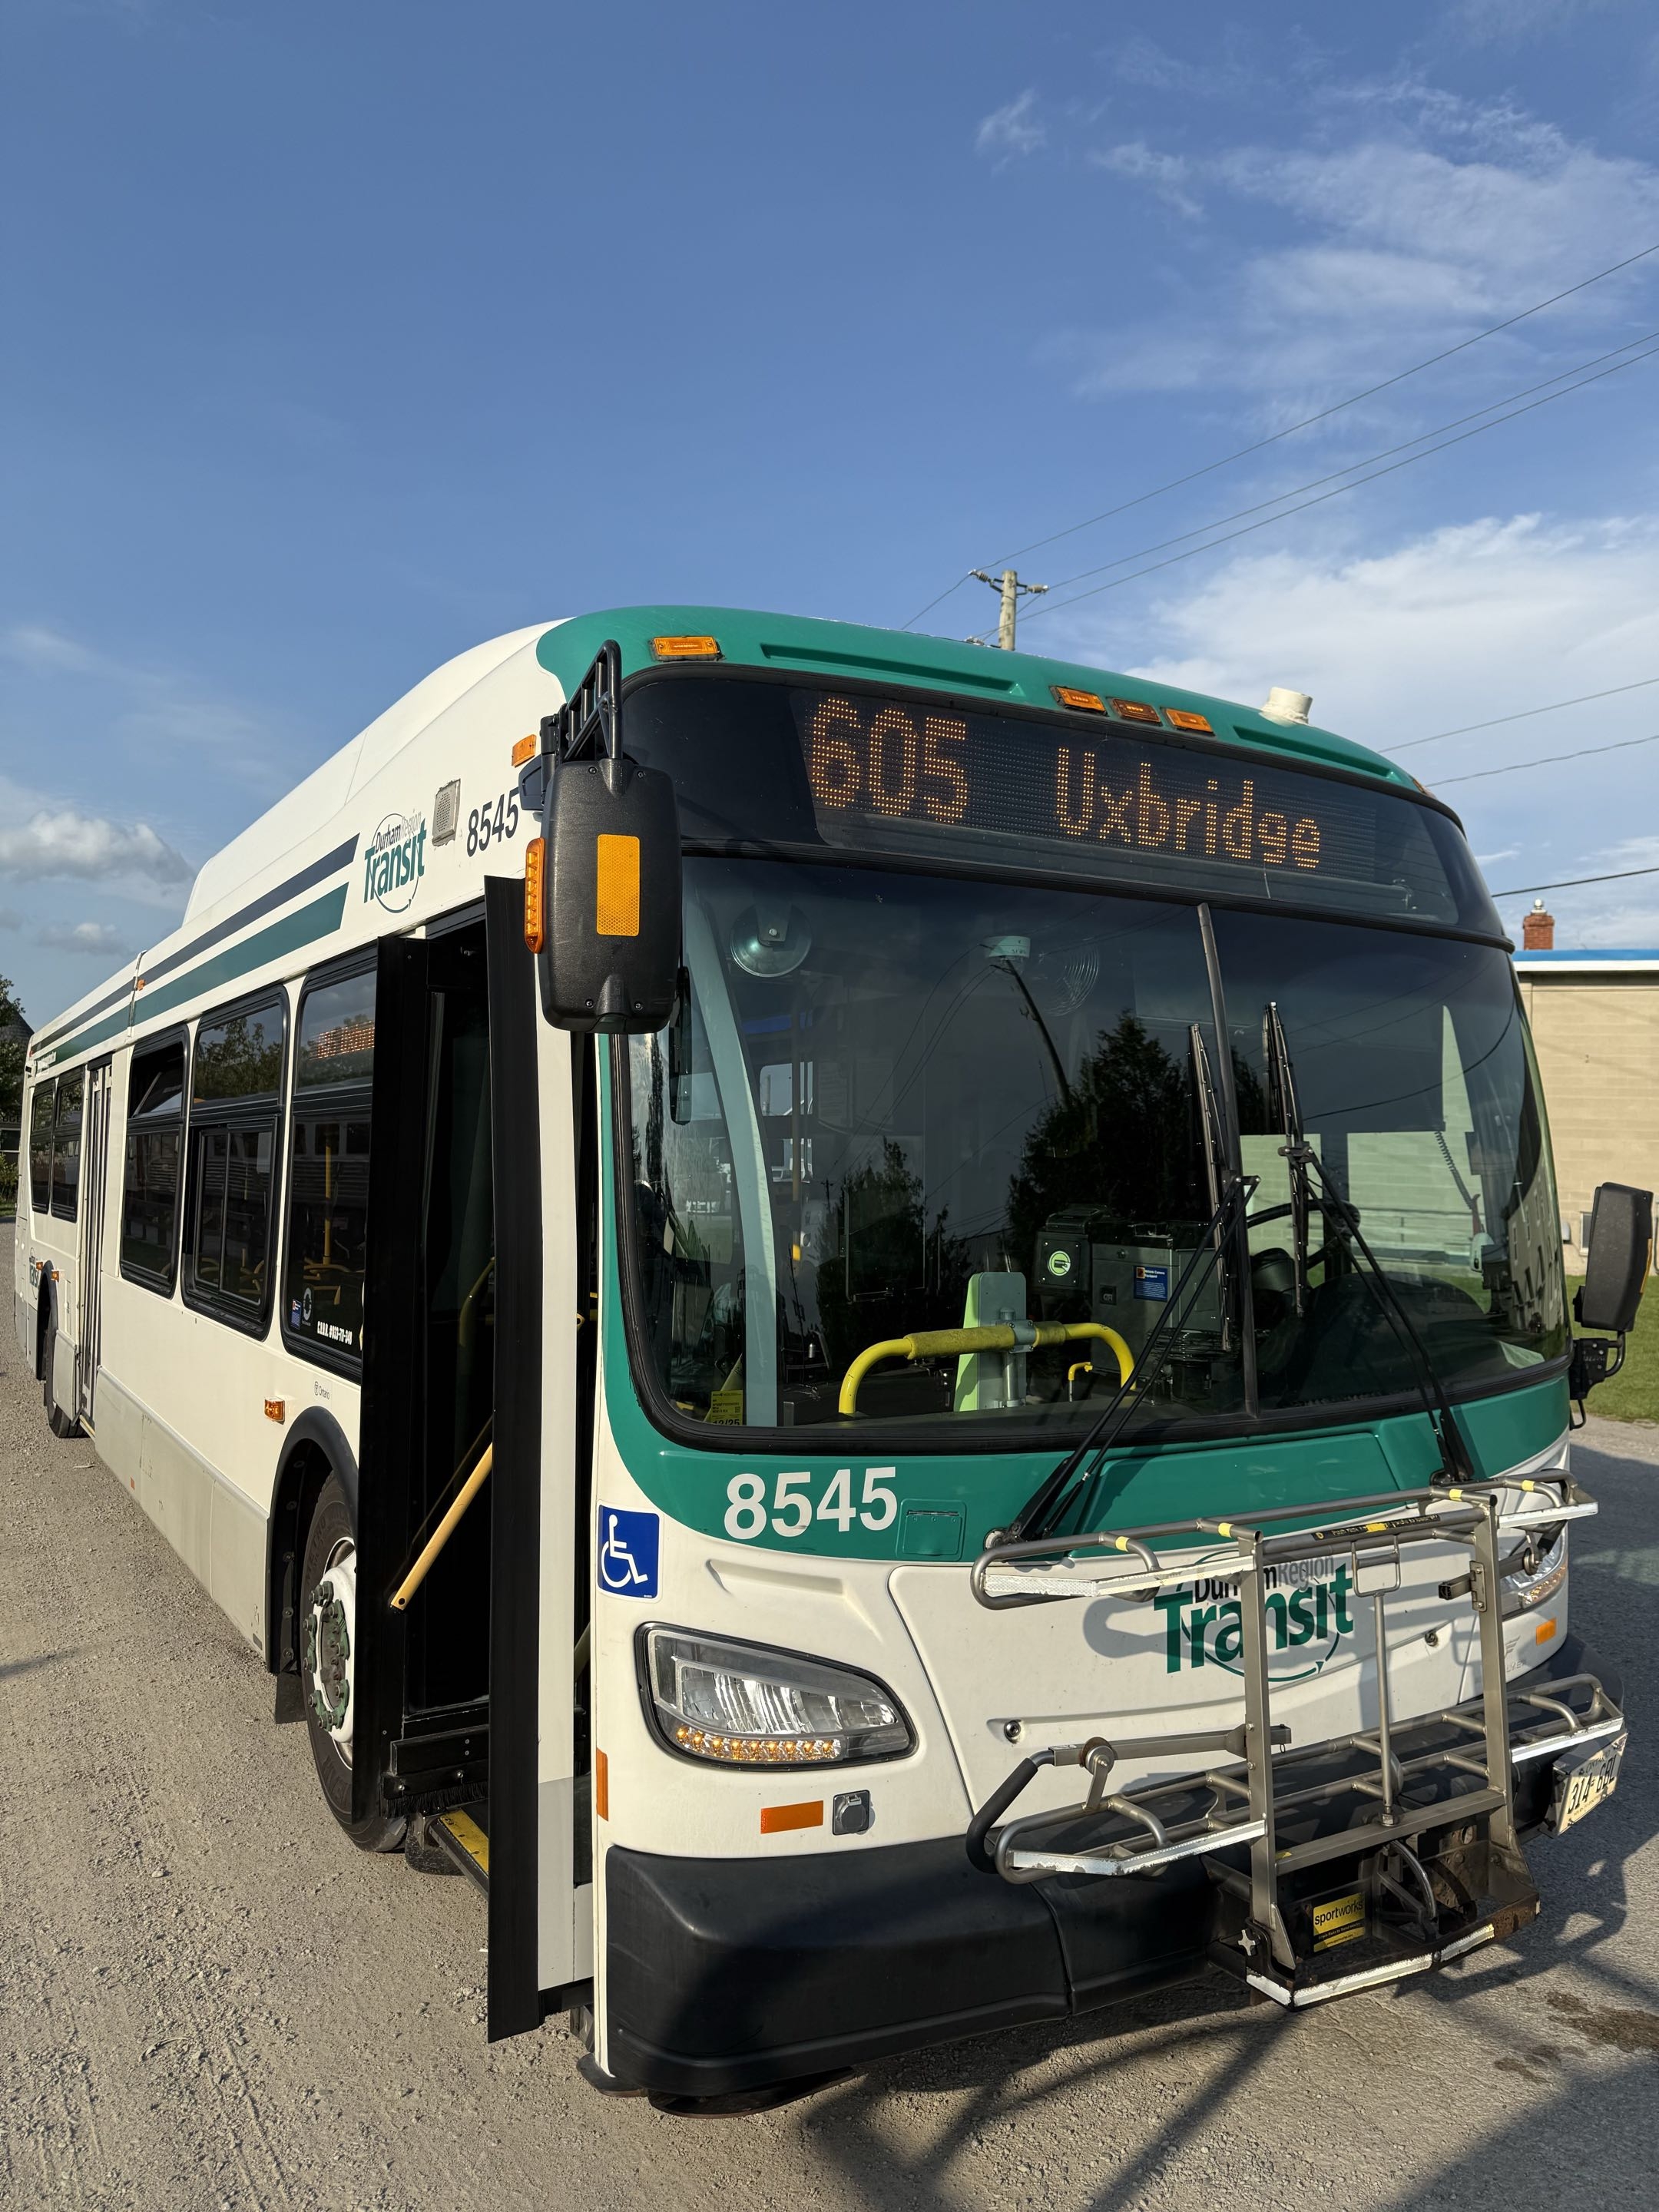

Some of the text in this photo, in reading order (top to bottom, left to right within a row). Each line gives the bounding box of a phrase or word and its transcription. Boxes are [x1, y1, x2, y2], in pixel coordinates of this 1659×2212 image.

[811, 697, 1321, 869] 605 Uxbridge
[466, 786, 519, 858] 8545
[364, 818, 427, 904] Transit
[319, 1386, 330, 1400] Ontario
[724, 1465, 898, 1540] 8545
[1154, 1563, 1353, 1674] Transit
[1314, 1900, 1363, 1926] sportworks
